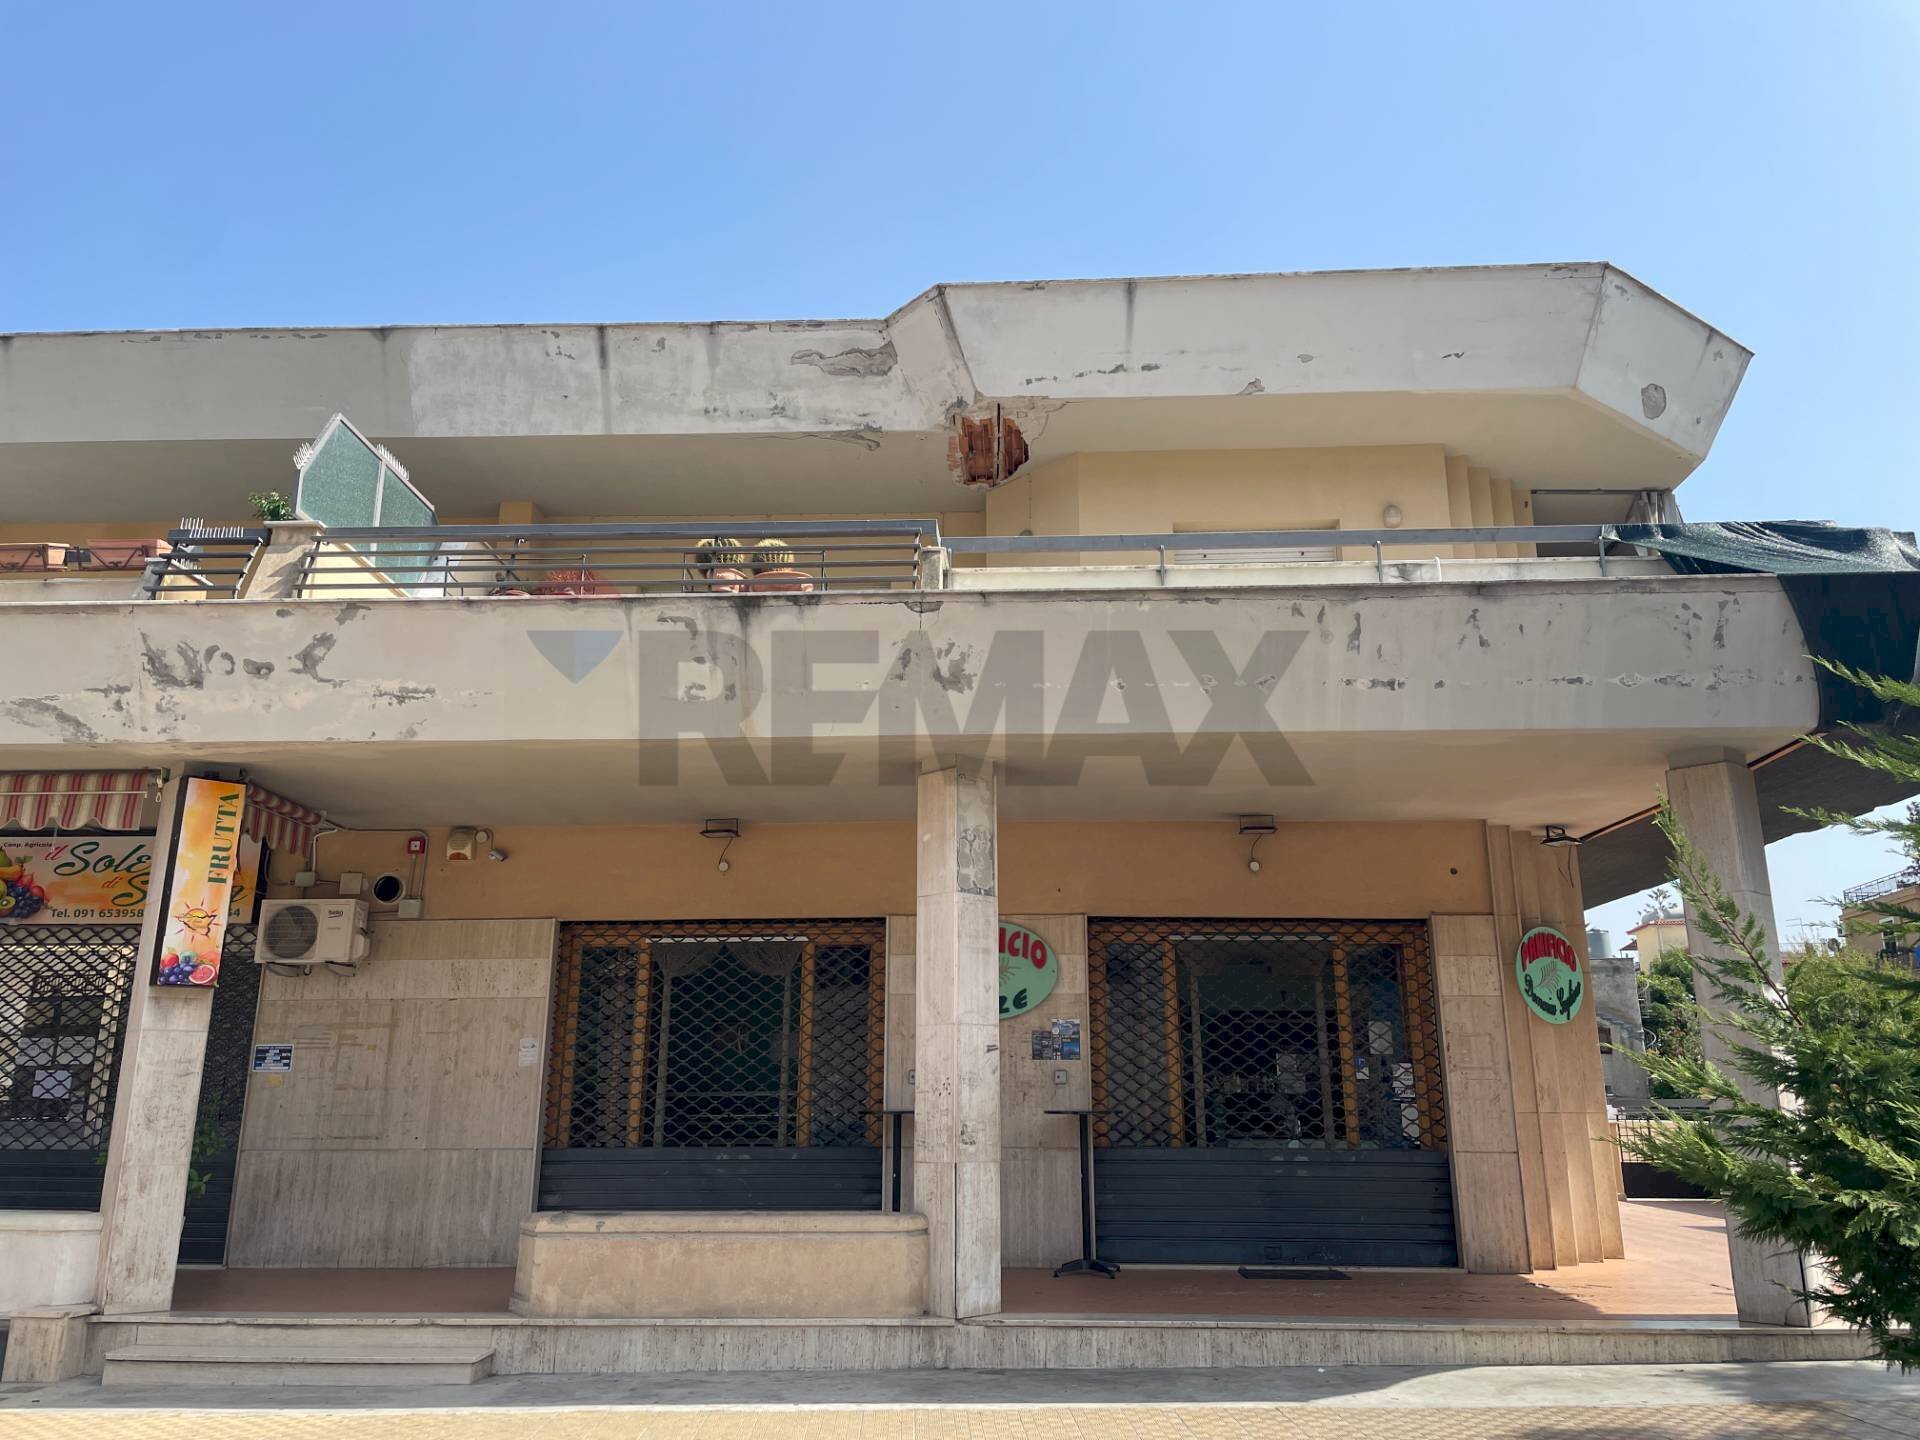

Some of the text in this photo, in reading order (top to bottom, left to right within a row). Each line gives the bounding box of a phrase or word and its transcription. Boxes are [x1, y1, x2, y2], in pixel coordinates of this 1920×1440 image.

[207, 793, 240, 884] FRUTTA
[54, 841, 152, 876] Sole
[51, 908, 70, 918] Tel.
[73, 908, 95, 918] 091
